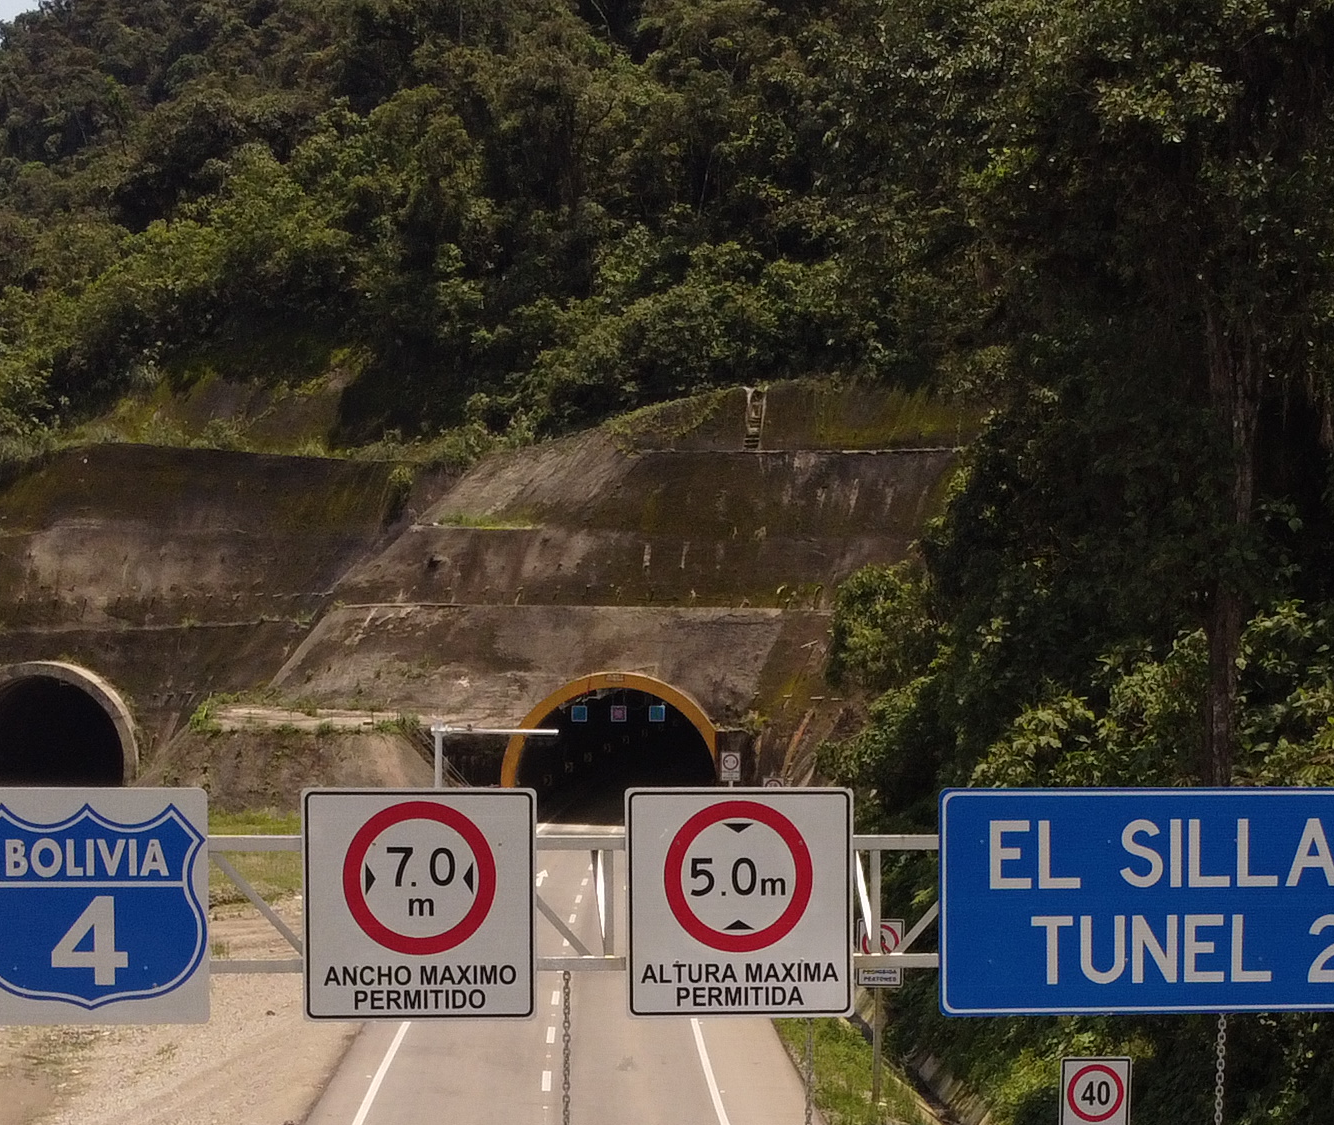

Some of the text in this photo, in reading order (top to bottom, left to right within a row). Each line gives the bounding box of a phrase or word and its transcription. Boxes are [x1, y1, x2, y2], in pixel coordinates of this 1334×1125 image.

[5, 839, 169, 878] BOLIVIA
[386, 846, 457, 888] 7.0
[989, 819, 1081, 890] EL
[407, 895, 435, 917] m
[50, 895, 129, 986] 4
[1030, 913, 1273, 985] TUNEL
[324, 964, 517, 986] ANCHO MAXIMO
[641, 962, 839, 984] ALTURA MAXIMA
[354, 989, 486, 1010] PERMITIDO
[677, 986, 804, 1007] PERMITIDA
[1080, 1080, 1111, 1106] 40
